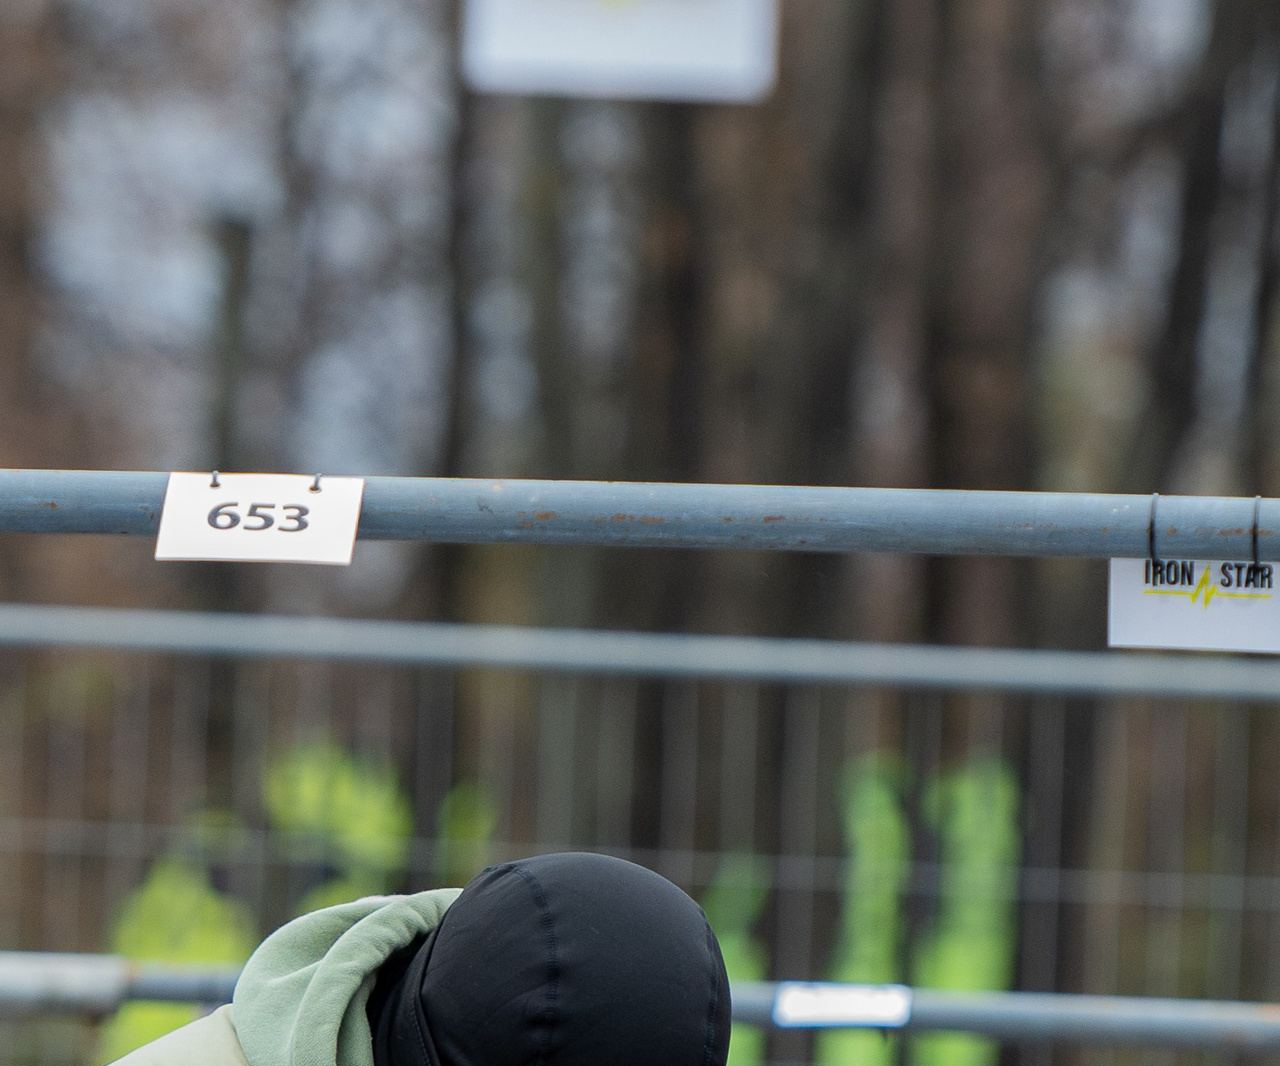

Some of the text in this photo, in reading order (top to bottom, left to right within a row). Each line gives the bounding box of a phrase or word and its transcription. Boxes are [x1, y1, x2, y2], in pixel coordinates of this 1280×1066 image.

[207, 502, 310, 532] 653
[1144, 559, 1274, 589] IRON STAR
